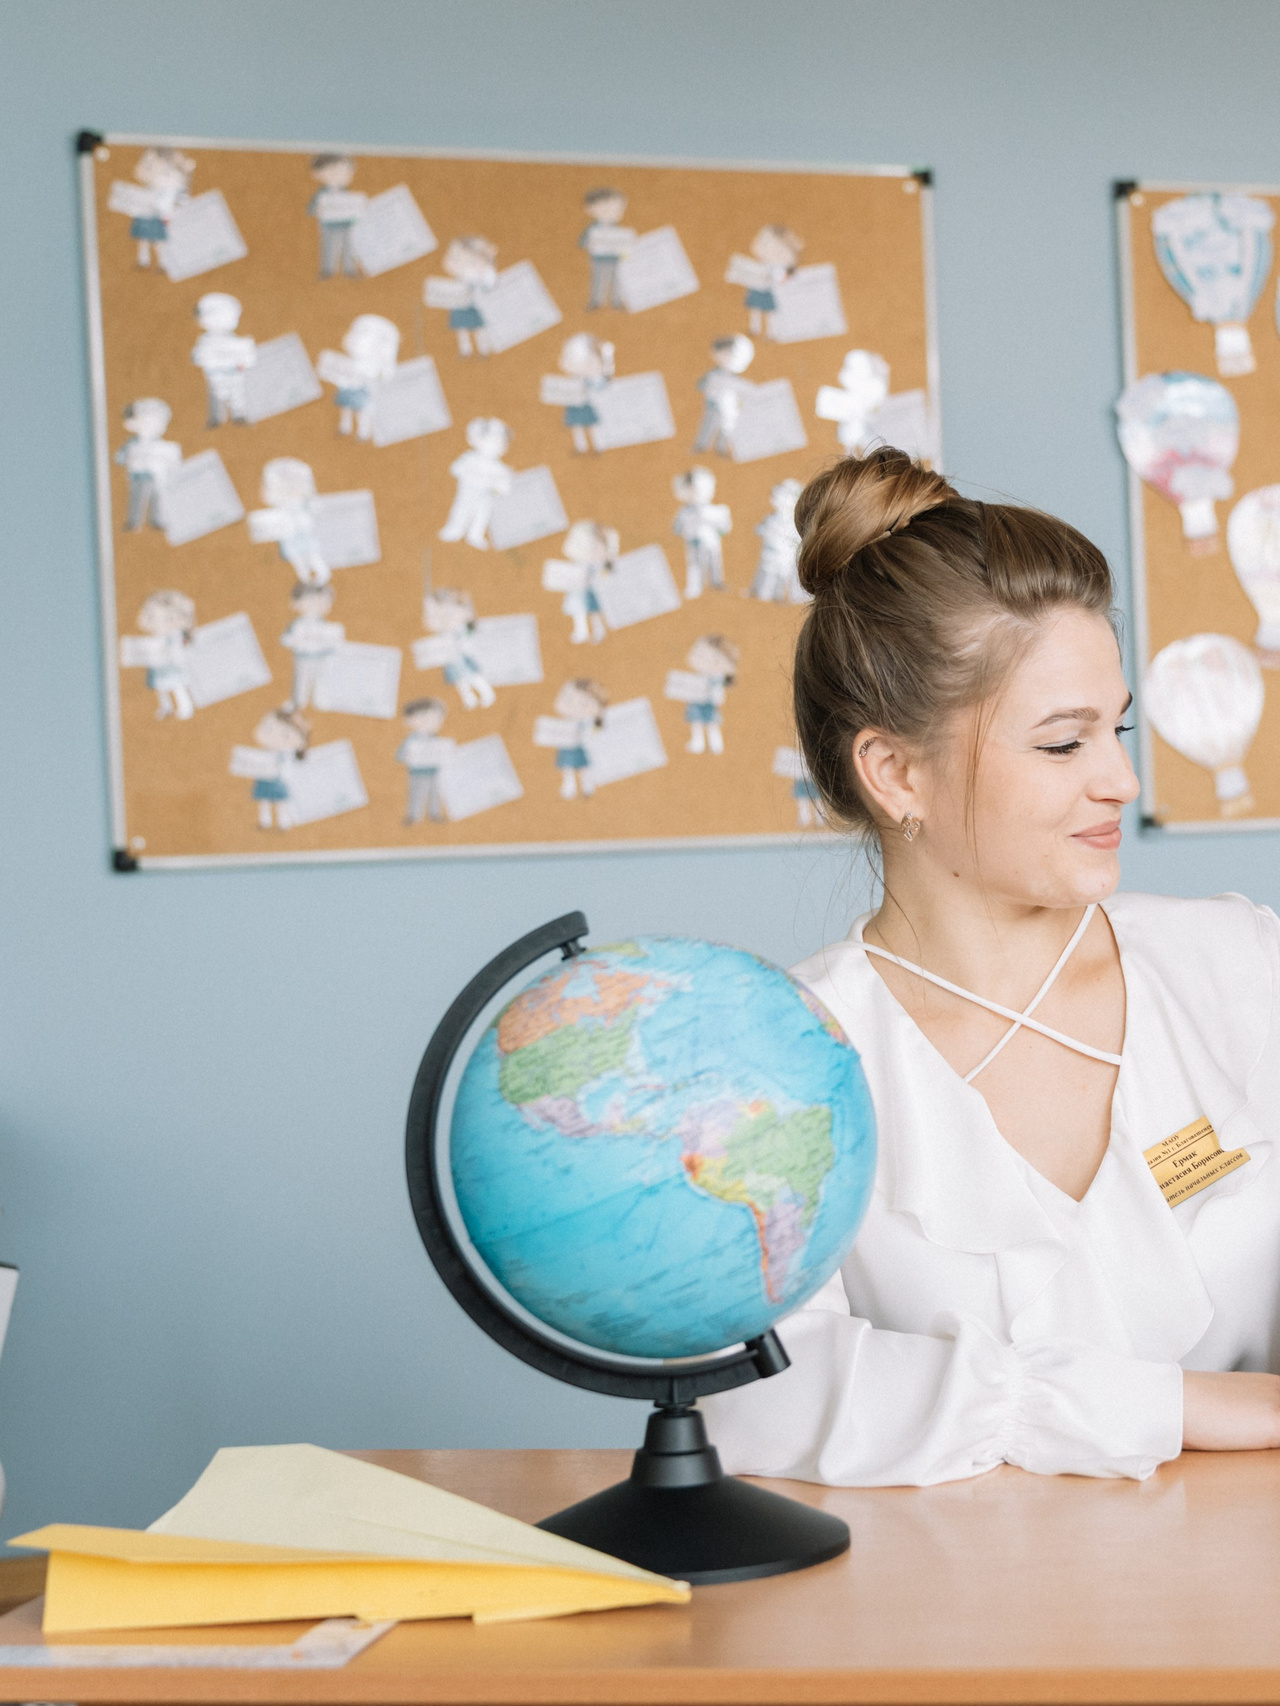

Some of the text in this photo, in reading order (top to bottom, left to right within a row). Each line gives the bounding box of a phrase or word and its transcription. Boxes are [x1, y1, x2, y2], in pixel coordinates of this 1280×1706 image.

[1172, 1150, 1198, 1168] Ермак
[1185, 1169, 1219, 1191] начальных
[1220, 1152, 1244, 1171] классов
